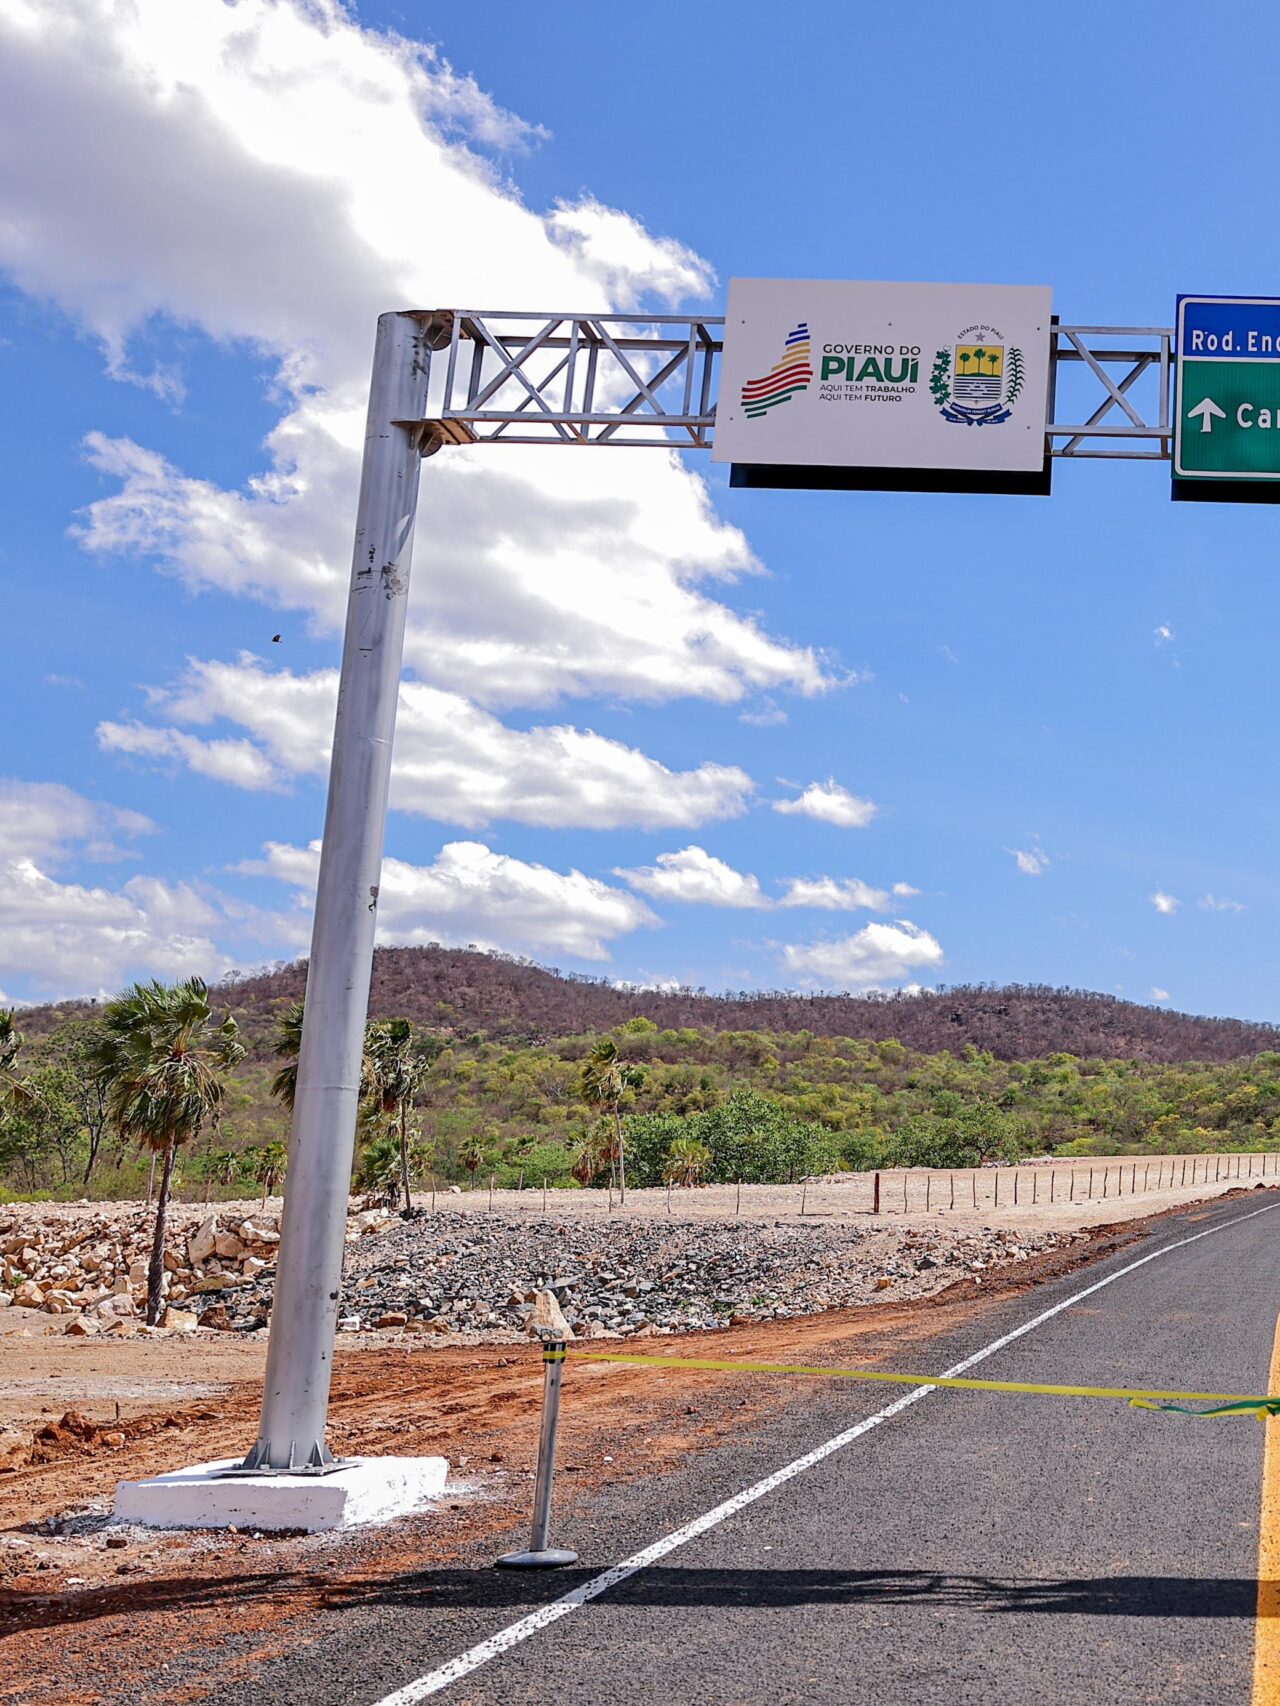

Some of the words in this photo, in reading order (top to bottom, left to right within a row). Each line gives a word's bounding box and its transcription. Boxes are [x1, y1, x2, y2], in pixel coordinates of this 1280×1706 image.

[957, 325, 979, 340] ESTADO
[1192, 329, 1241, 351] Rod.
[823, 344, 894, 355] GOVERNO
[900, 345, 921, 356] DO
[821, 356, 919, 383] PIAUÍ
[820, 384, 842, 392] AQUI
[819, 393, 842, 401] AQUI
